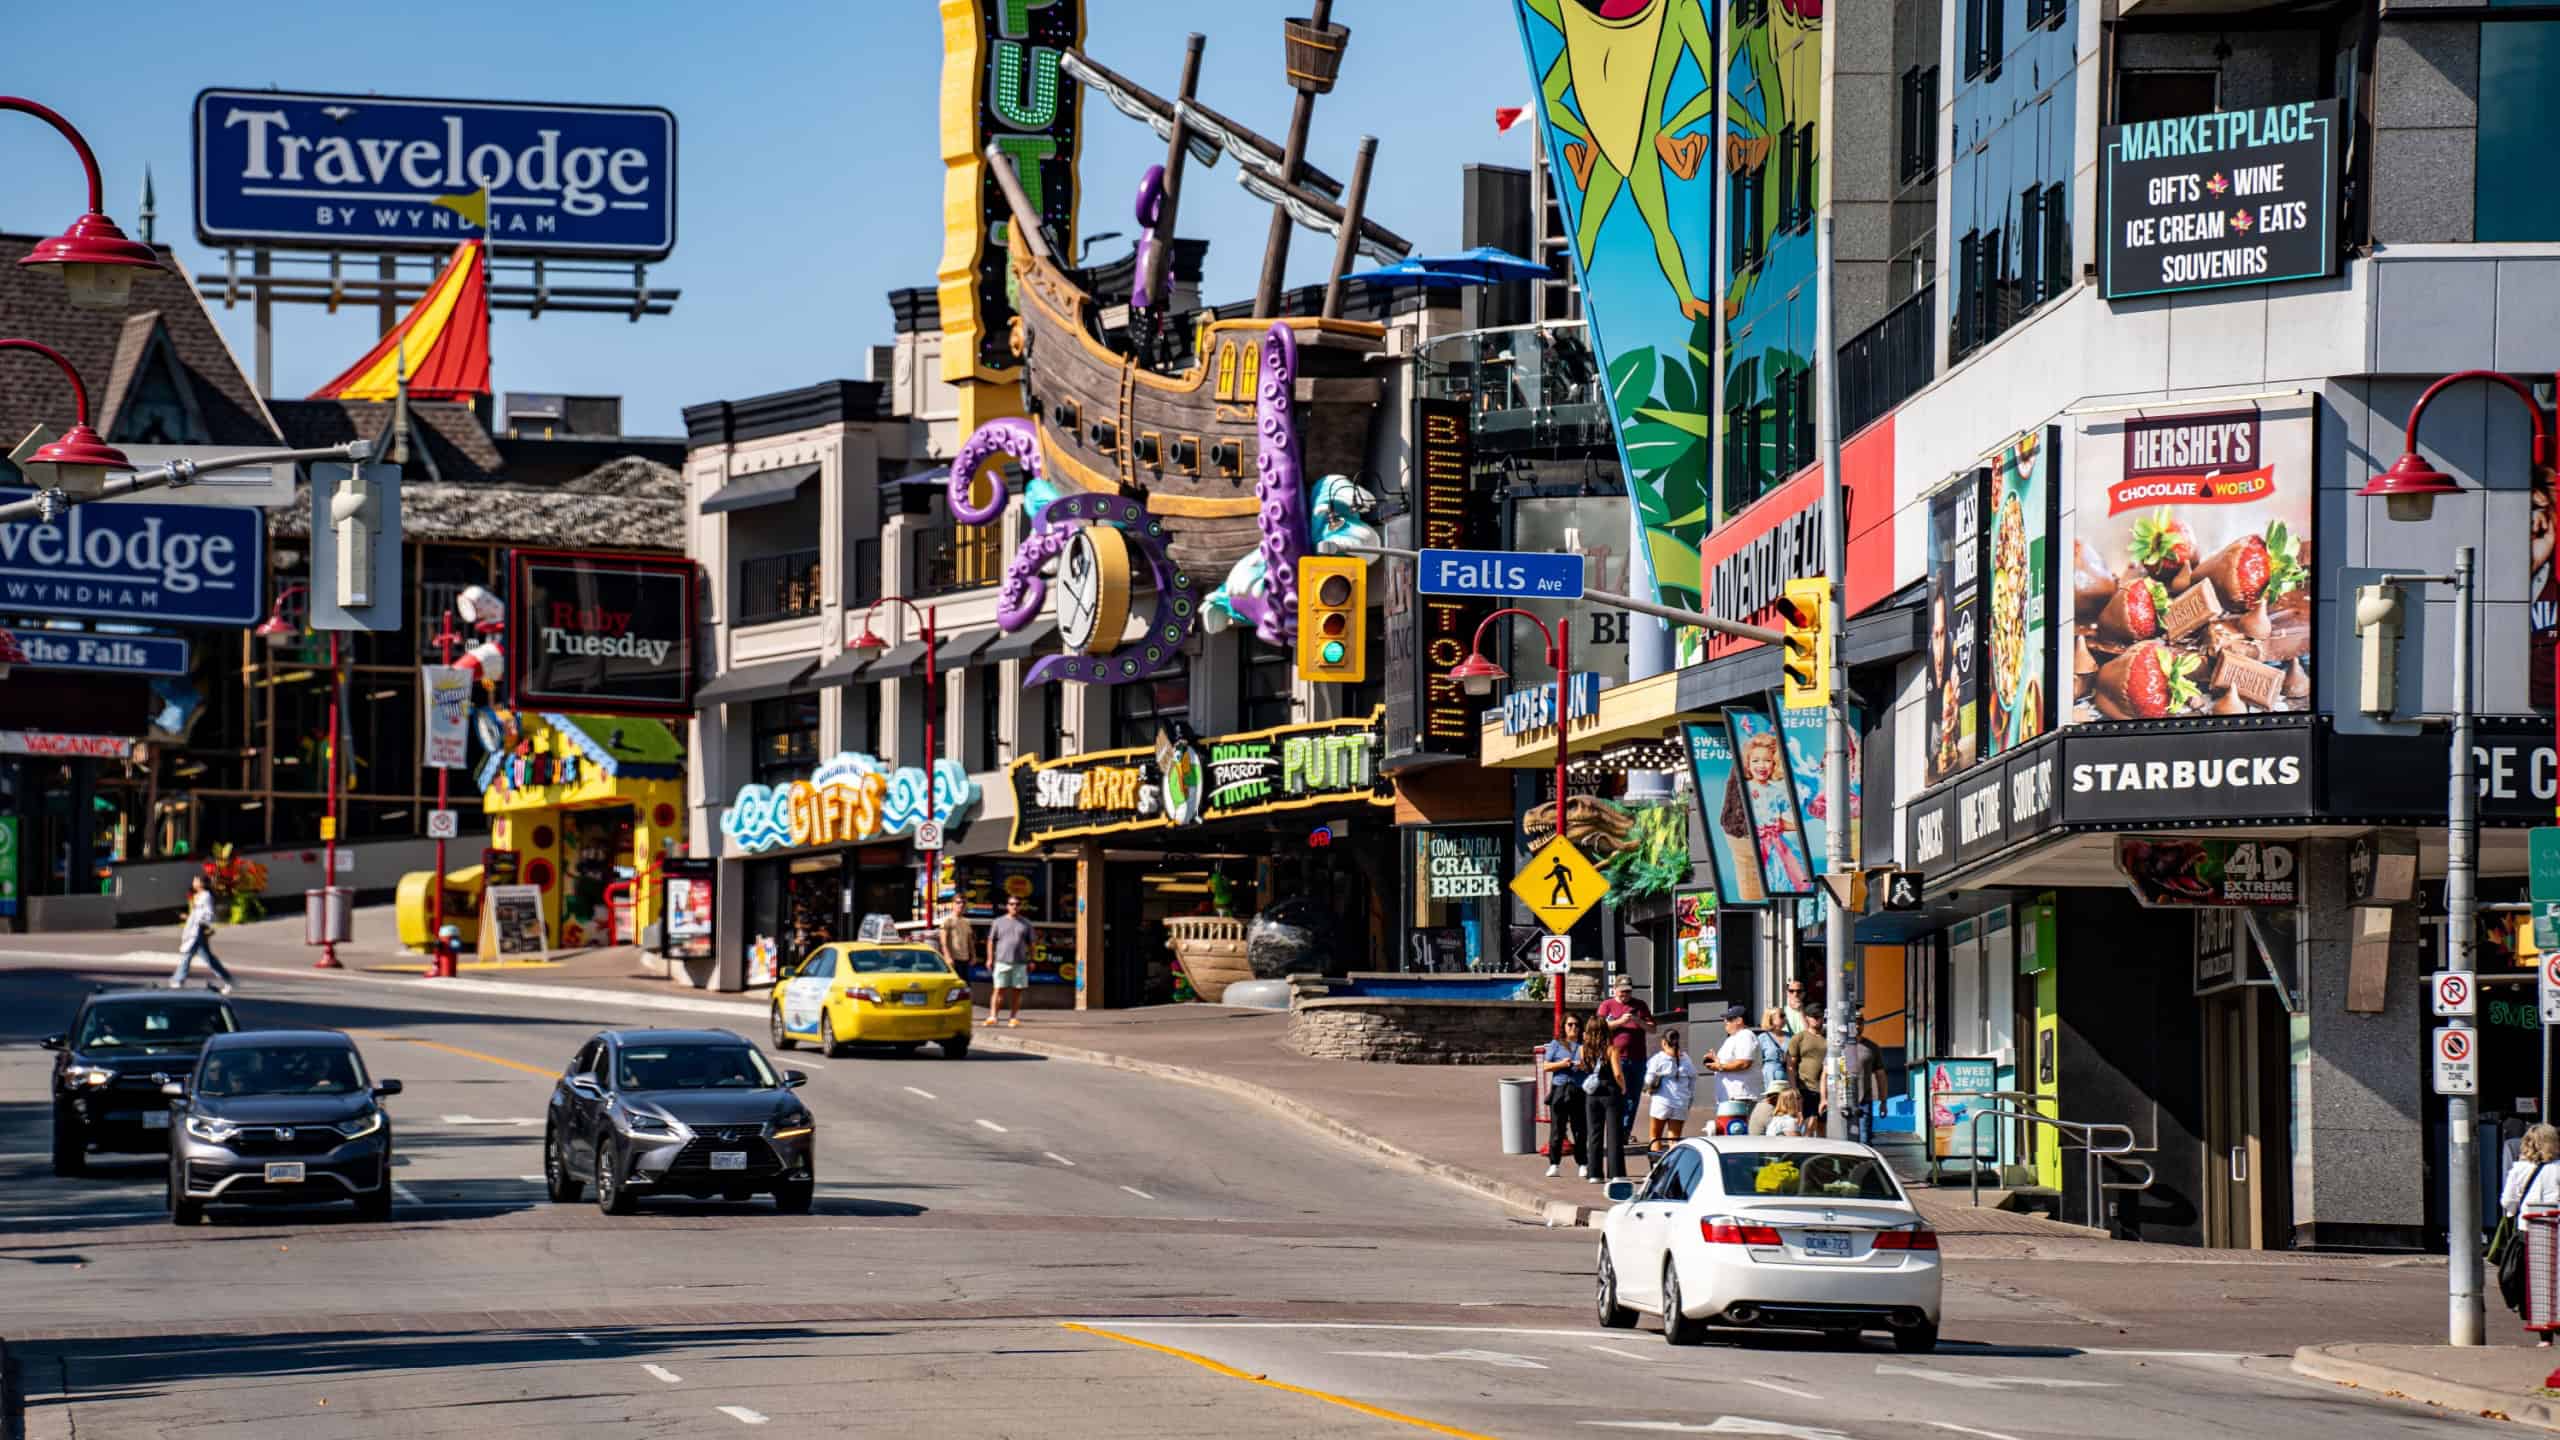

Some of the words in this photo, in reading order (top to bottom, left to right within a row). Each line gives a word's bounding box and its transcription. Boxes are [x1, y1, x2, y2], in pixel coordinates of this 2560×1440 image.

[2120, 102, 2315, 162] MARKETPLACE
[225, 108, 649, 217] Travelodge
[2149, 174, 2200, 206] GIFTS
[2234, 163, 2285, 196] WINE
[316, 206, 357, 226] BY
[2126, 218, 2155, 248] ICE
[2159, 211, 2225, 245] CREAM
[2259, 201, 2307, 234] EATS
[2162, 246, 2268, 283] SOUVENIRS
[2134, 423, 2251, 470] HERSHEY'S
[1428, 415, 1463, 549] BEER
[2119, 483, 2197, 503] CHOCOLATE
[2216, 478, 2265, 495] WORLD
[1440, 559, 1526, 591] Falls
[1537, 577, 1562, 591] Ave
[7, 582, 159, 606] WYNDHAM
[551, 603, 632, 635] Ruby
[76, 640, 148, 666] Falls
[541, 627, 672, 666] Tuesday
[24, 735, 126, 757] VACANCY
[1693, 736, 1729, 747] SWEE
[1213, 763, 1264, 786] PARROT
[1284, 733, 1375, 792] PUTT
[2072, 755, 2300, 793] STARBUCKS
[790, 773, 884, 846] GIFTS
[1431, 838, 1459, 857] COME
[2223, 843, 2294, 881] 4D
[1431, 857, 1501, 875] CRAFT
[1431, 875, 1502, 898] BEER
[2223, 881, 2294, 892] EXTREME
[1955, 1066, 1993, 1076] SWEET
